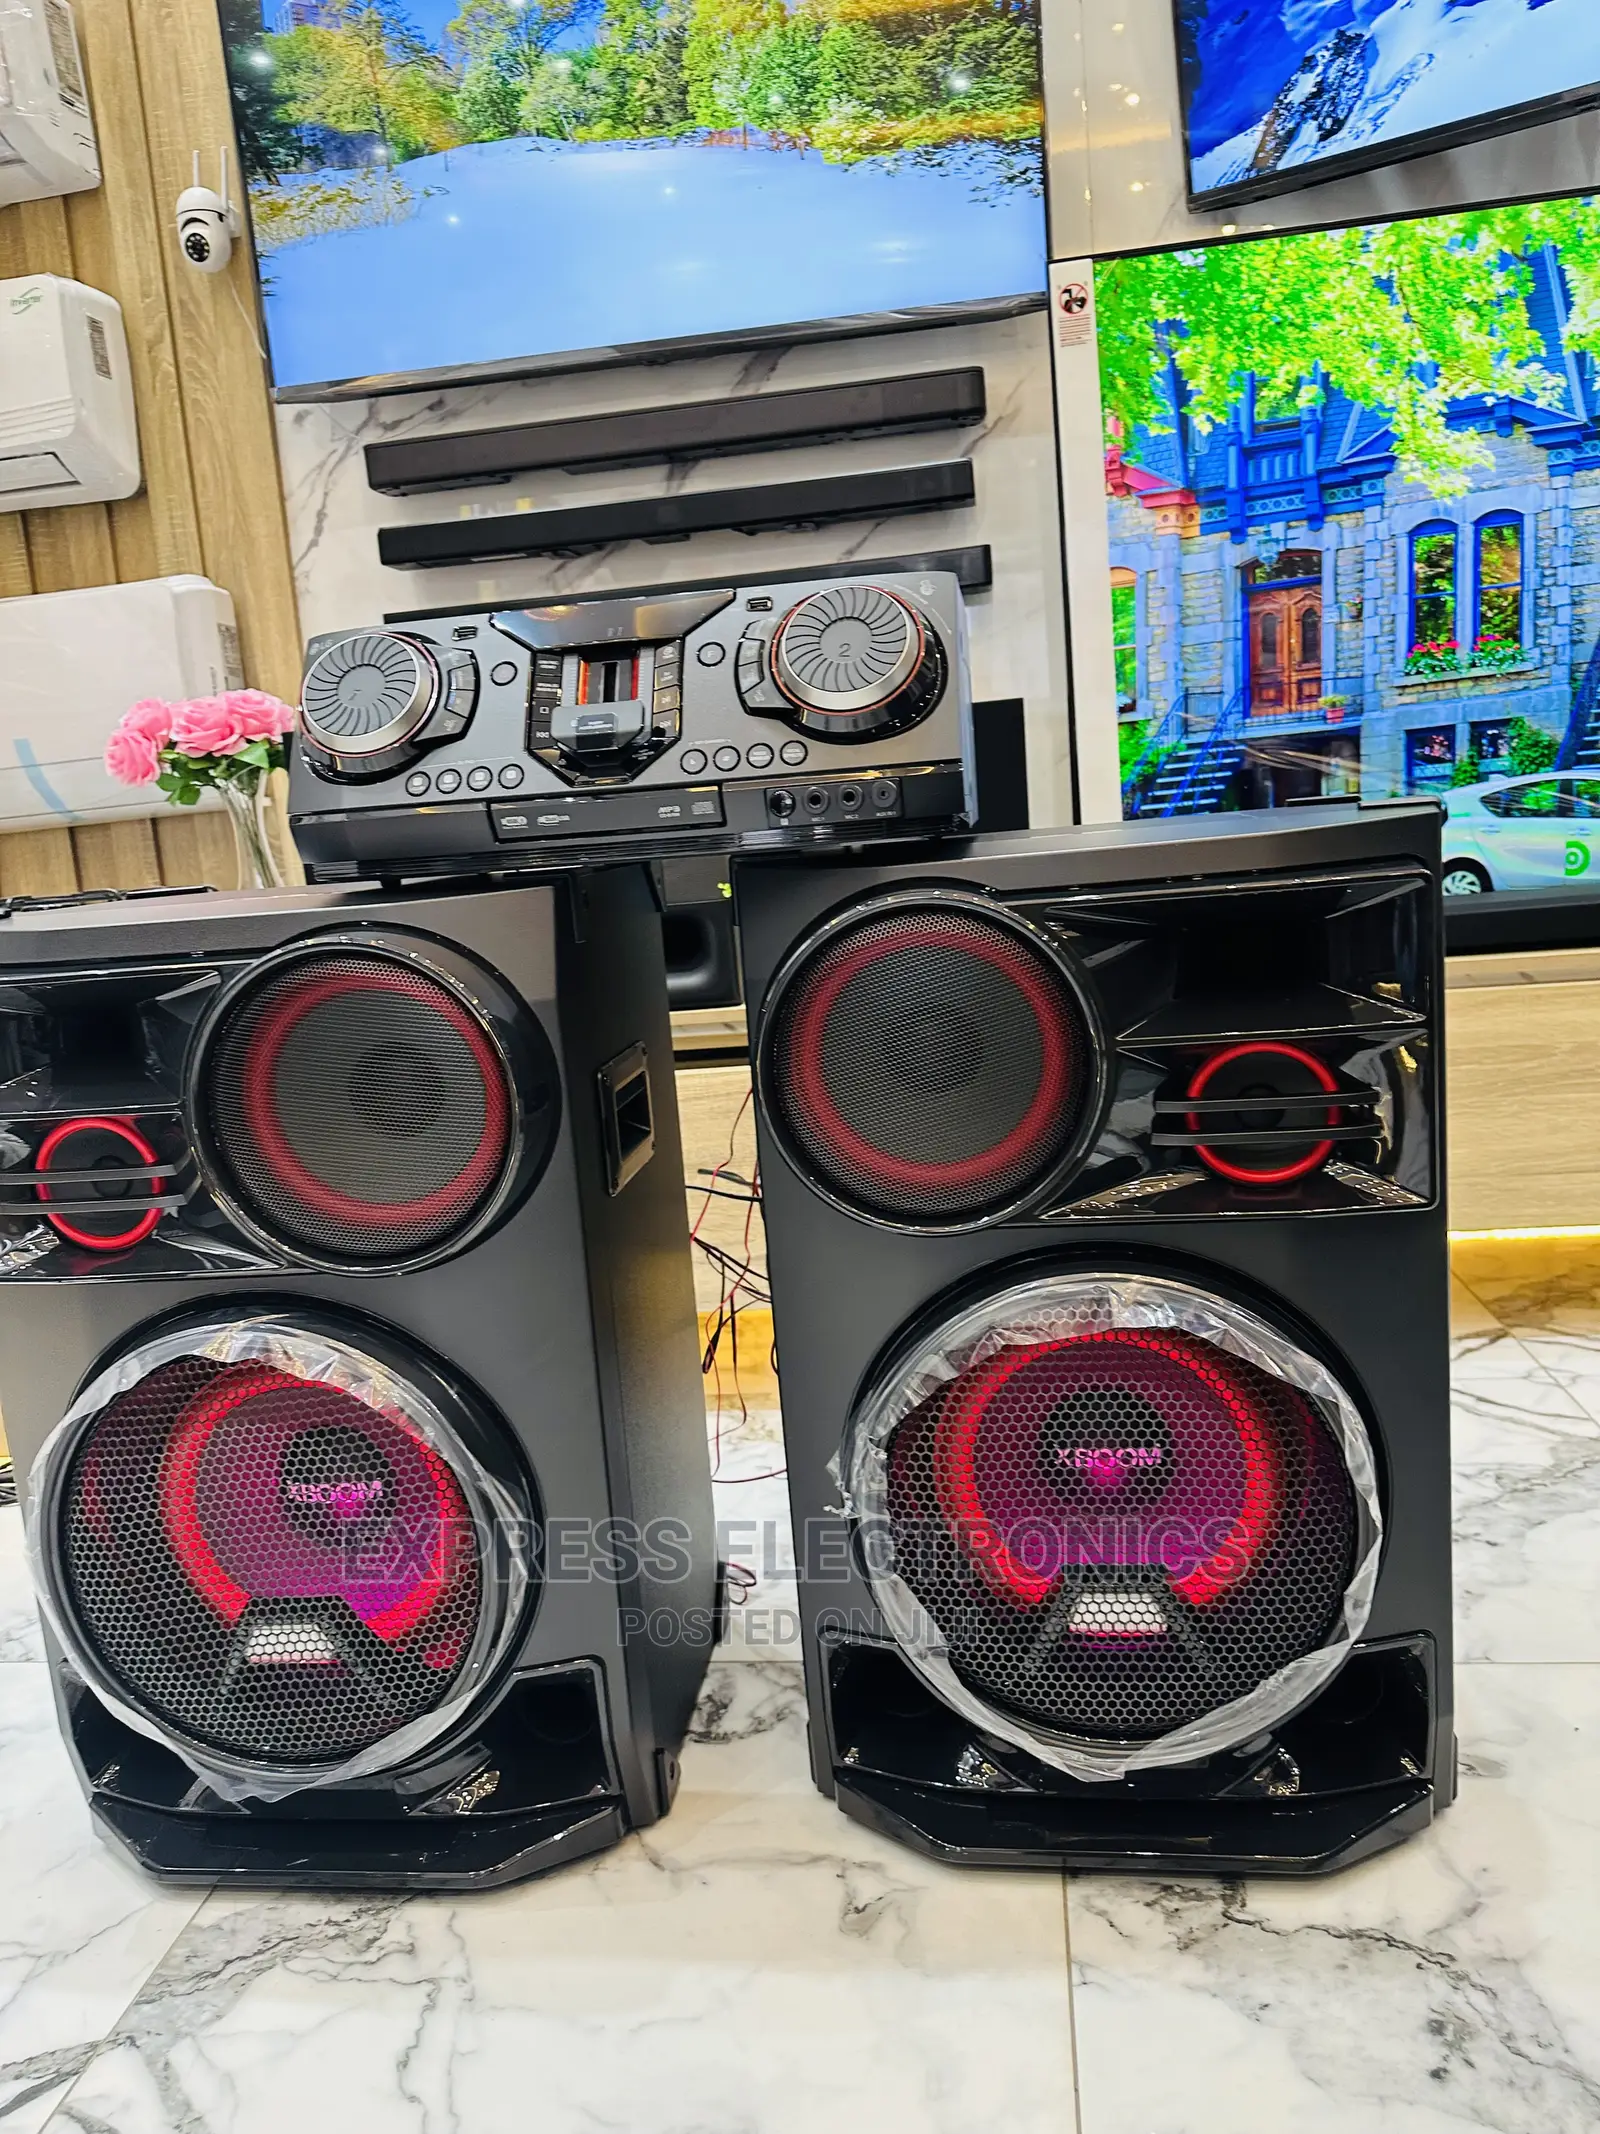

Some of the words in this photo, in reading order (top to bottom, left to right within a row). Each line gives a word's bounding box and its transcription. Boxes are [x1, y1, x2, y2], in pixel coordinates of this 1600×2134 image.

[838, 642, 851, 658] 2
[1053, 1443, 1162, 1469] XBOOM
[285, 1479, 384, 1504] XBOOM
